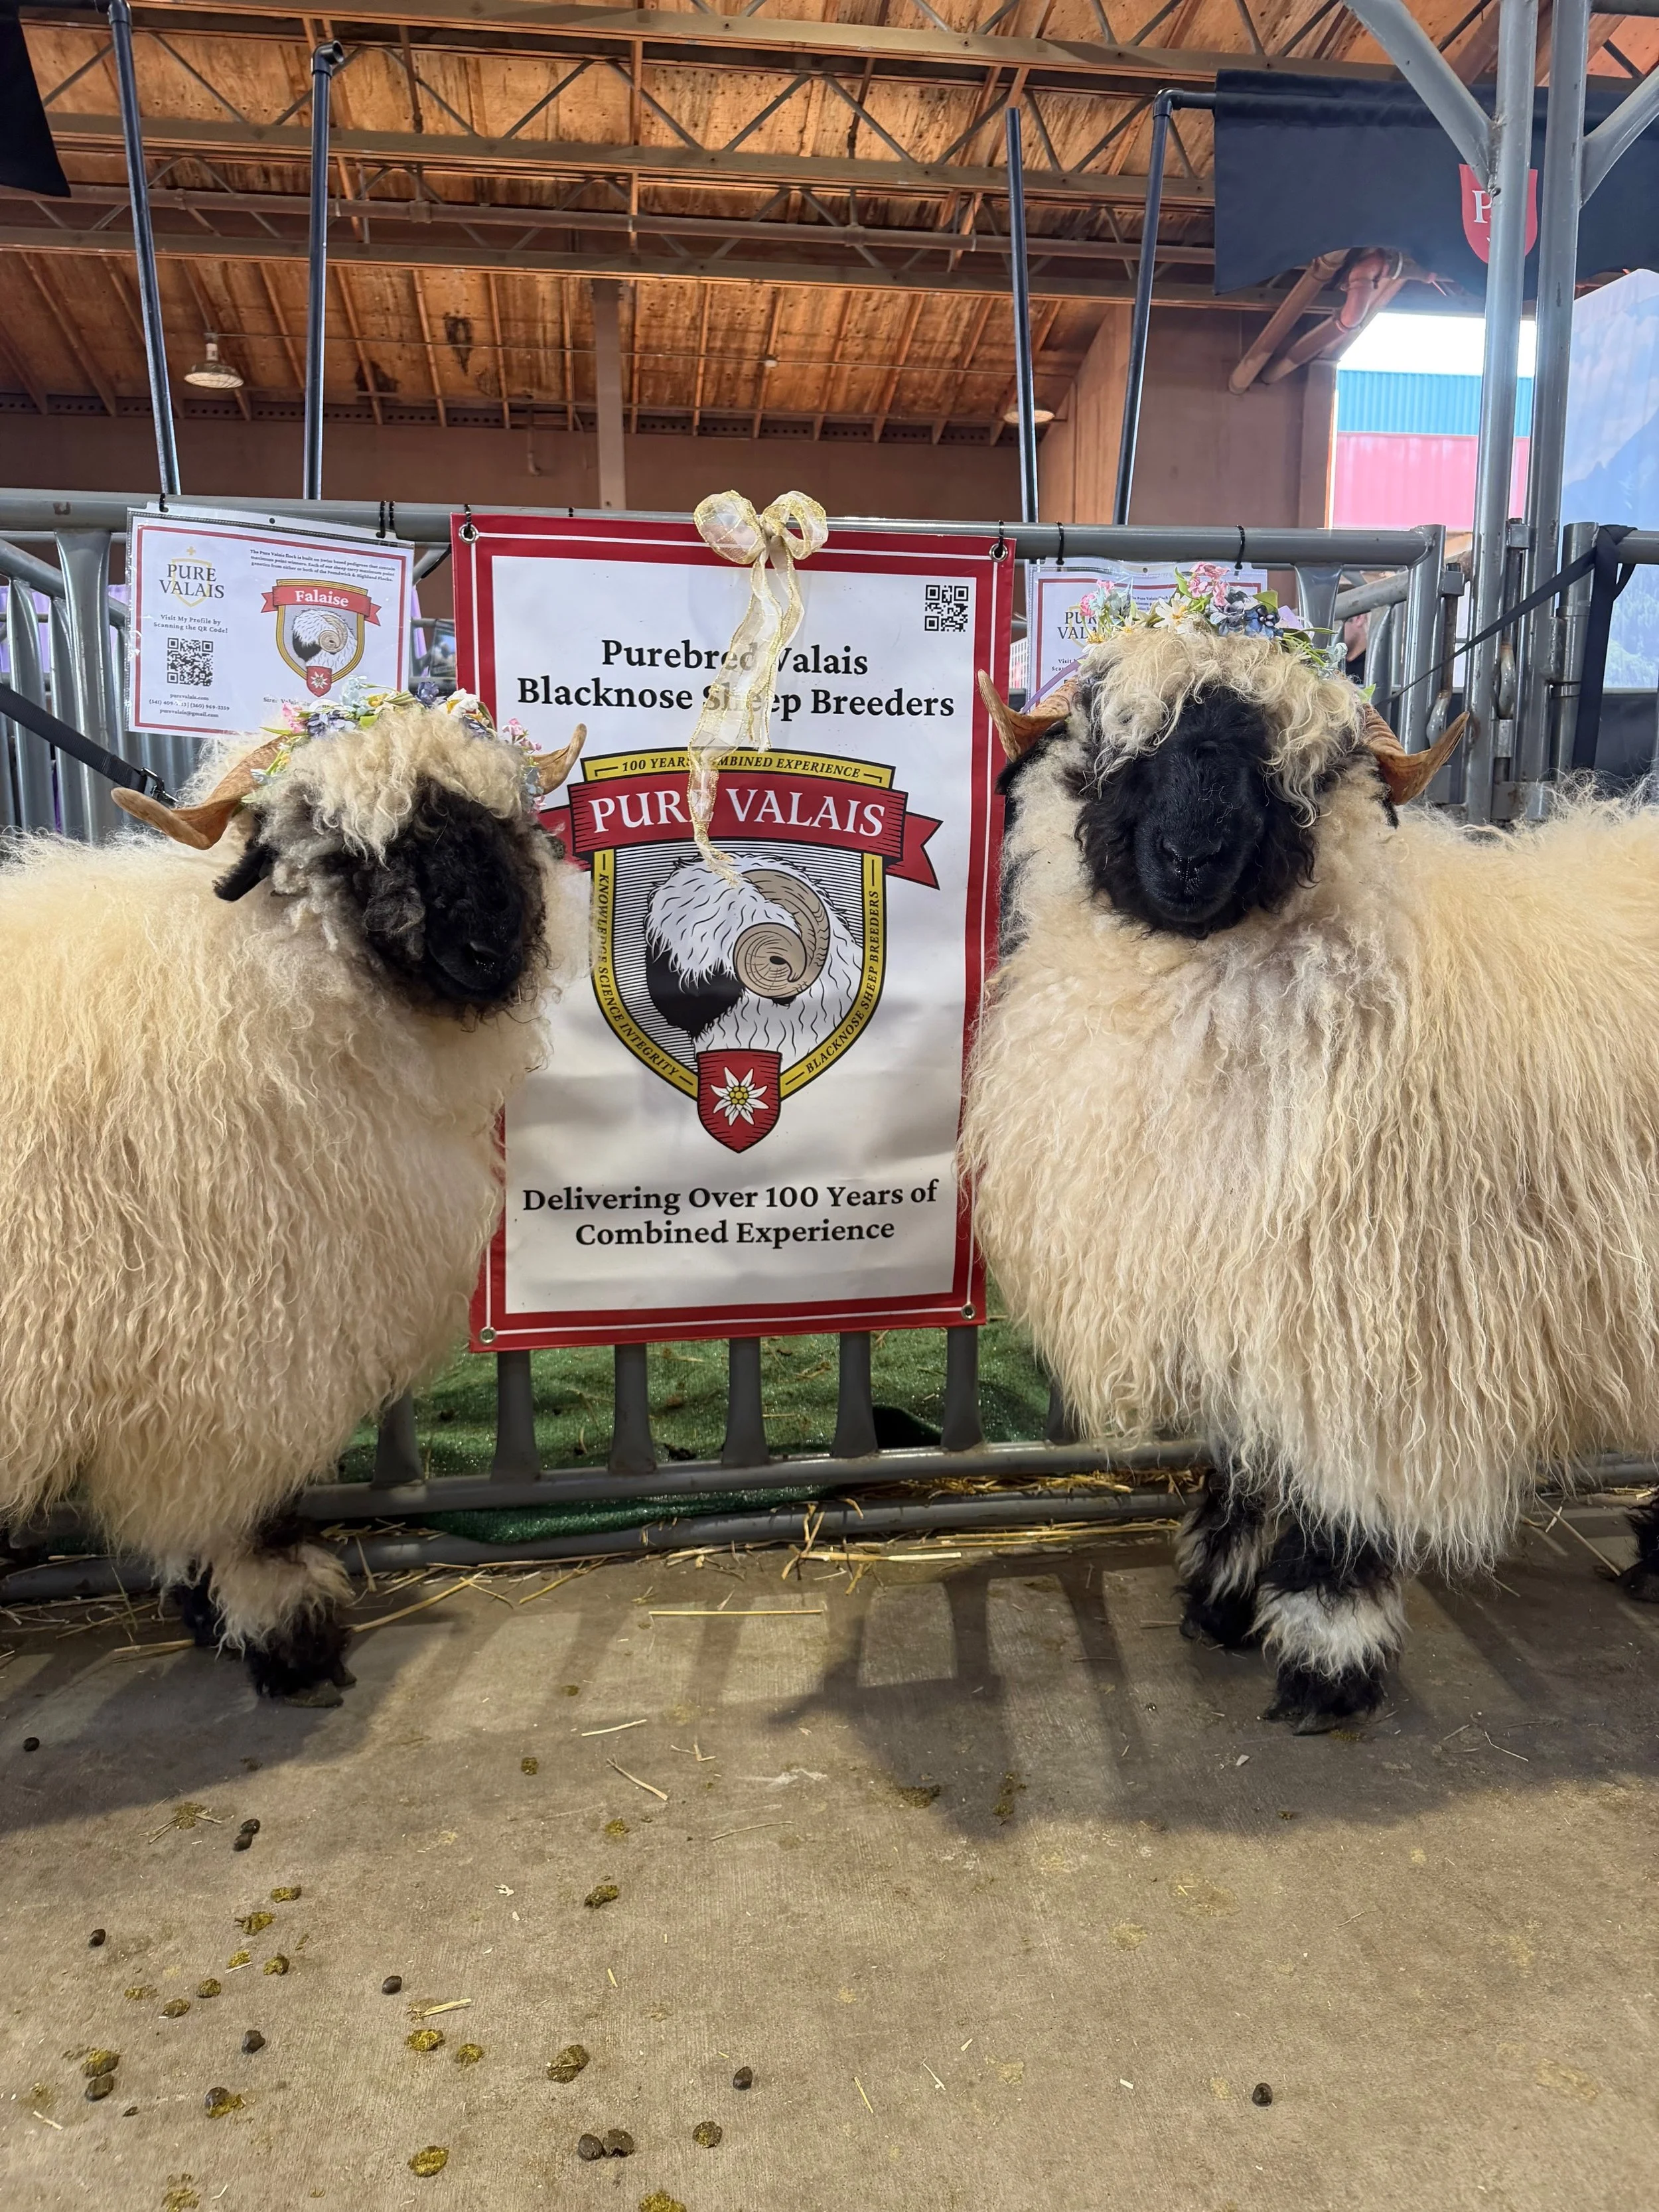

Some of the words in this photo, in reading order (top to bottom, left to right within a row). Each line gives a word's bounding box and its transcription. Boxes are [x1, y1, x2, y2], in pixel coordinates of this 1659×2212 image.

[159, 579, 224, 599] VALAIS
[167, 564, 217, 582] PURE
[295, 589, 349, 607] Falaise
[153, 622, 184, 630] Scanning
[601, 639, 758, 672] Purebred
[775, 644, 868, 675] Valais
[517, 675, 693, 709] Blacknose
[703, 682, 802, 721] Sheep
[811, 688, 954, 716] Breeders
[622, 759, 646, 772] 100
[776, 758, 861, 777] EXPERIENCE
[725, 788, 886, 838] VALAIS
[869, 891, 880, 962] BREEDERS
[861, 966, 878, 1009] SHEEP
[599, 967, 624, 1021] SCIENCE
[620, 1023, 680, 1075] INTEGRITY
[806, 1010, 865, 1073] BLACKNOSE
[523, 1186, 681, 1215] Delivering
[689, 1188, 758, 1208] Over
[766, 1187, 819, 1207] 100
[827, 1187, 903, 1207] Years
[910, 1179, 940, 1203] of
[576, 1220, 729, 1245] Combined
[737, 1218, 895, 1249] Experience
